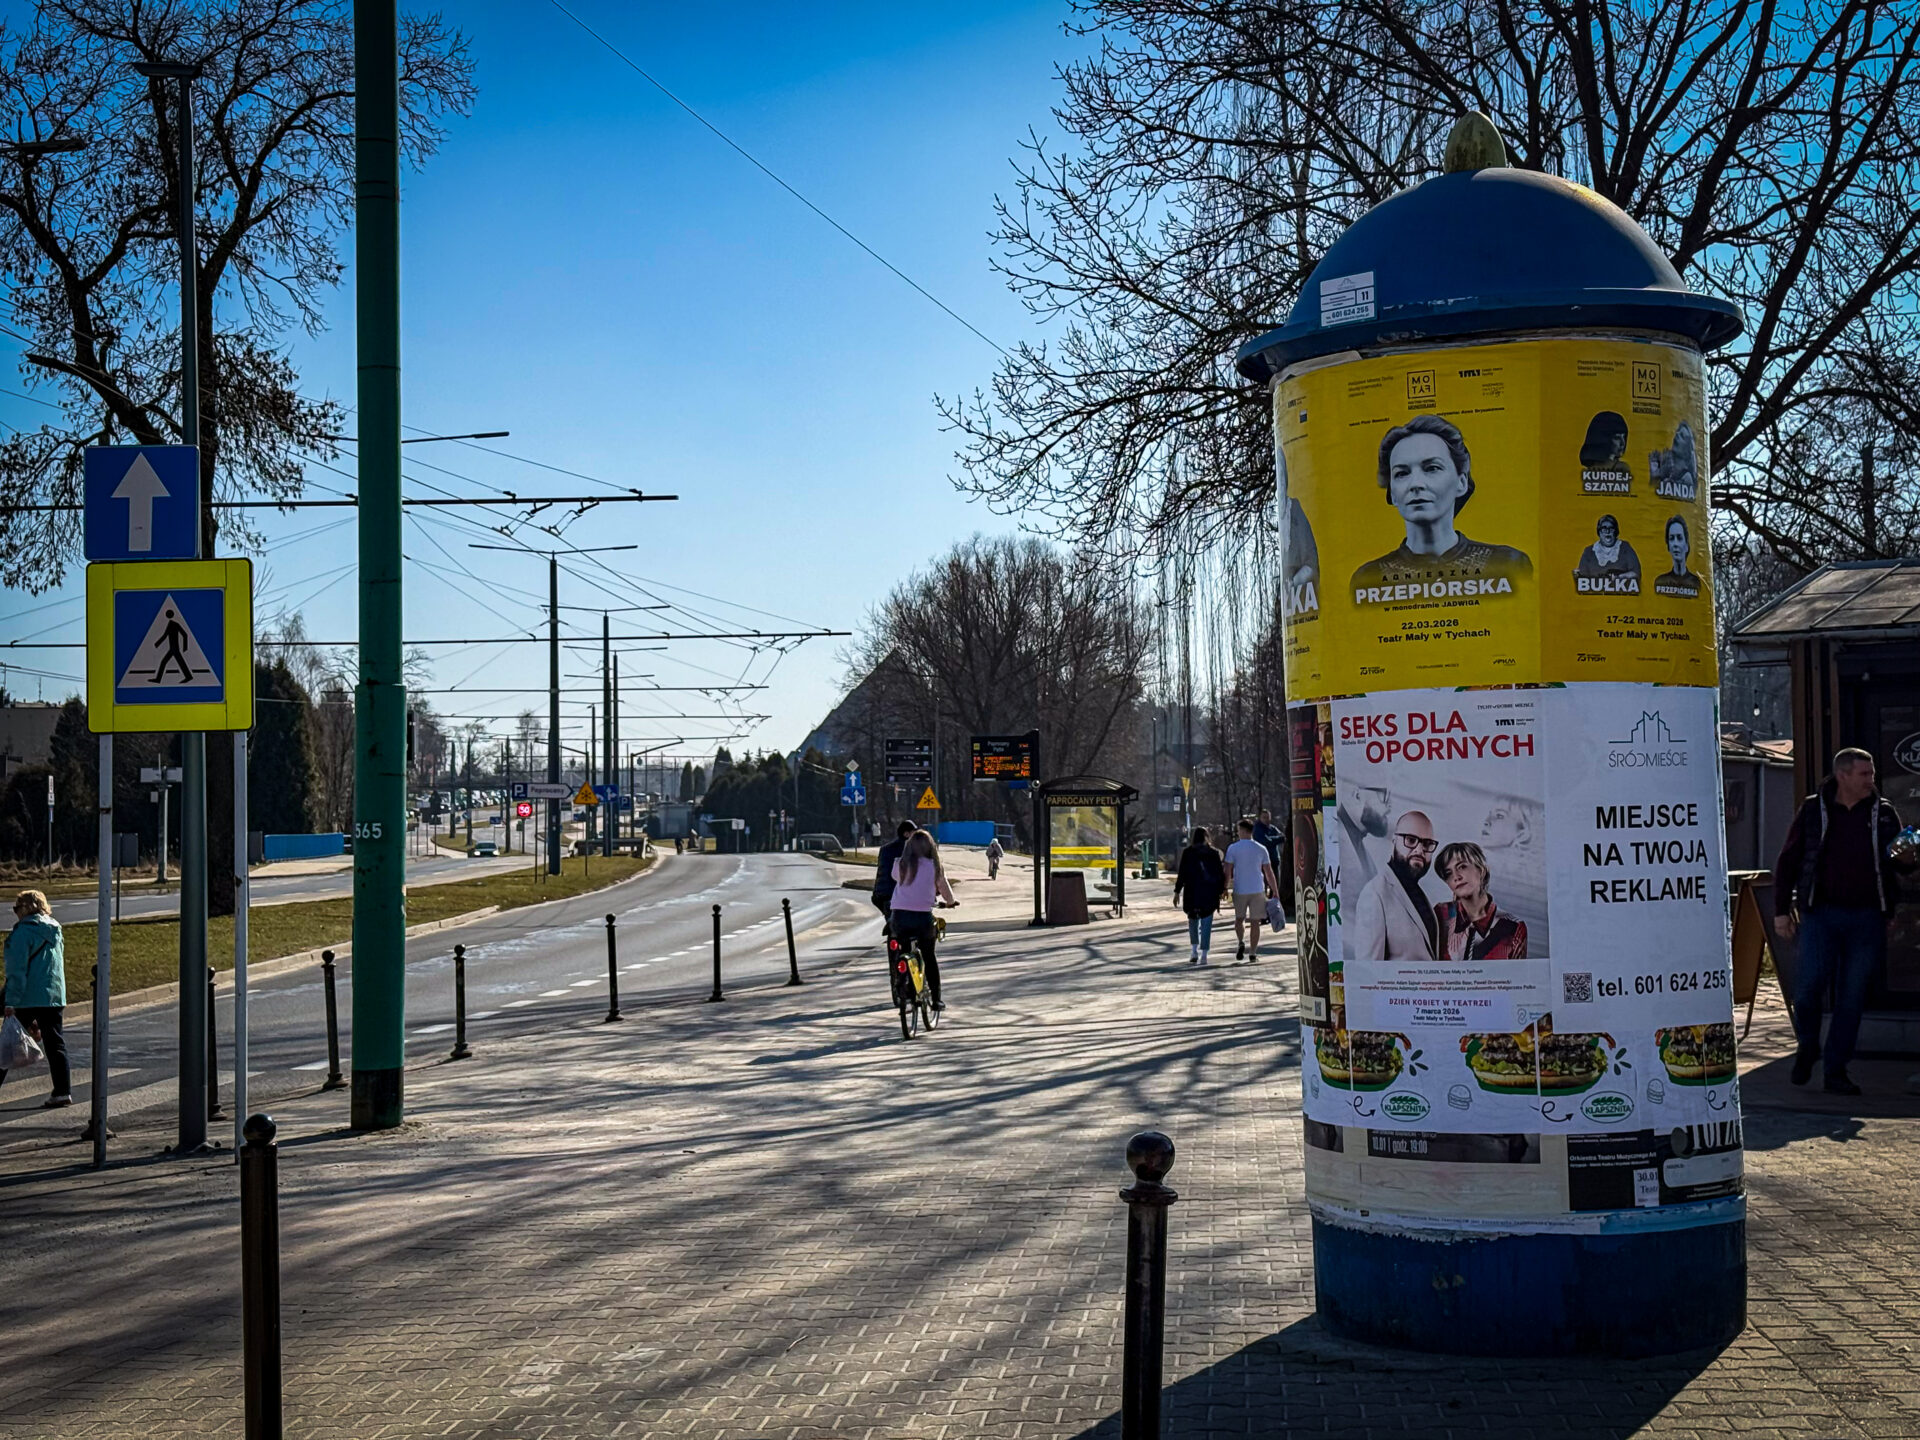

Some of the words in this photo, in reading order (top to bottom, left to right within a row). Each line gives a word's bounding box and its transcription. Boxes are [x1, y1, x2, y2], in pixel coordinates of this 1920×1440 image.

[1362, 291, 1368, 300] 11
[1356, 306, 1368, 314] 255
[1582, 471, 1632, 481] KURDEJ-
[1584, 482, 1629, 492] SZATAN
[1656, 481, 1696, 499] JANDA
[1382, 568, 1481, 582] AGNIESZKA
[1356, 578, 1512, 604] PRZEPIÓRSKA
[1578, 578, 1640, 592] BUŁKA
[1392, 602, 1440, 611] monodramie
[1442, 600, 1480, 608] JADWIGA
[1402, 618, 1459, 630] 22.03.2026
[1638, 617, 1664, 625] marca
[1378, 634, 1402, 644] Teatr
[1406, 632, 1430, 642] Mały
[1444, 628, 1491, 640] Tychach
[1597, 630, 1623, 638] Teatr
[1626, 630, 1648, 640] Mały
[1660, 631, 1690, 641] Tychach
[1340, 714, 1398, 739] SEKS
[1408, 710, 1468, 736] DLA
[1366, 734, 1534, 764] OPORNYCH
[1608, 749, 1688, 768] ŚRÓDMIEŚCIE
[1047, 796, 1094, 805] PAPROCANY
[1596, 803, 1698, 830] MIEJSCE
[356, 822, 382, 839] 565
[1584, 842, 1624, 867] NA
[1630, 839, 1708, 868] TWOJĄ
[1590, 876, 1707, 904] REKLAMĘ
[1597, 976, 1628, 997] tel.
[1635, 974, 1663, 994] 601
[1670, 972, 1698, 992] 624
[1703, 969, 1726, 990] 255
[1389, 997, 1410, 1006] DZIEŃ
[1384, 1104, 1427, 1113] KLAPSZNITA
[1585, 1106, 1631, 1114] KLAPSZNITA
